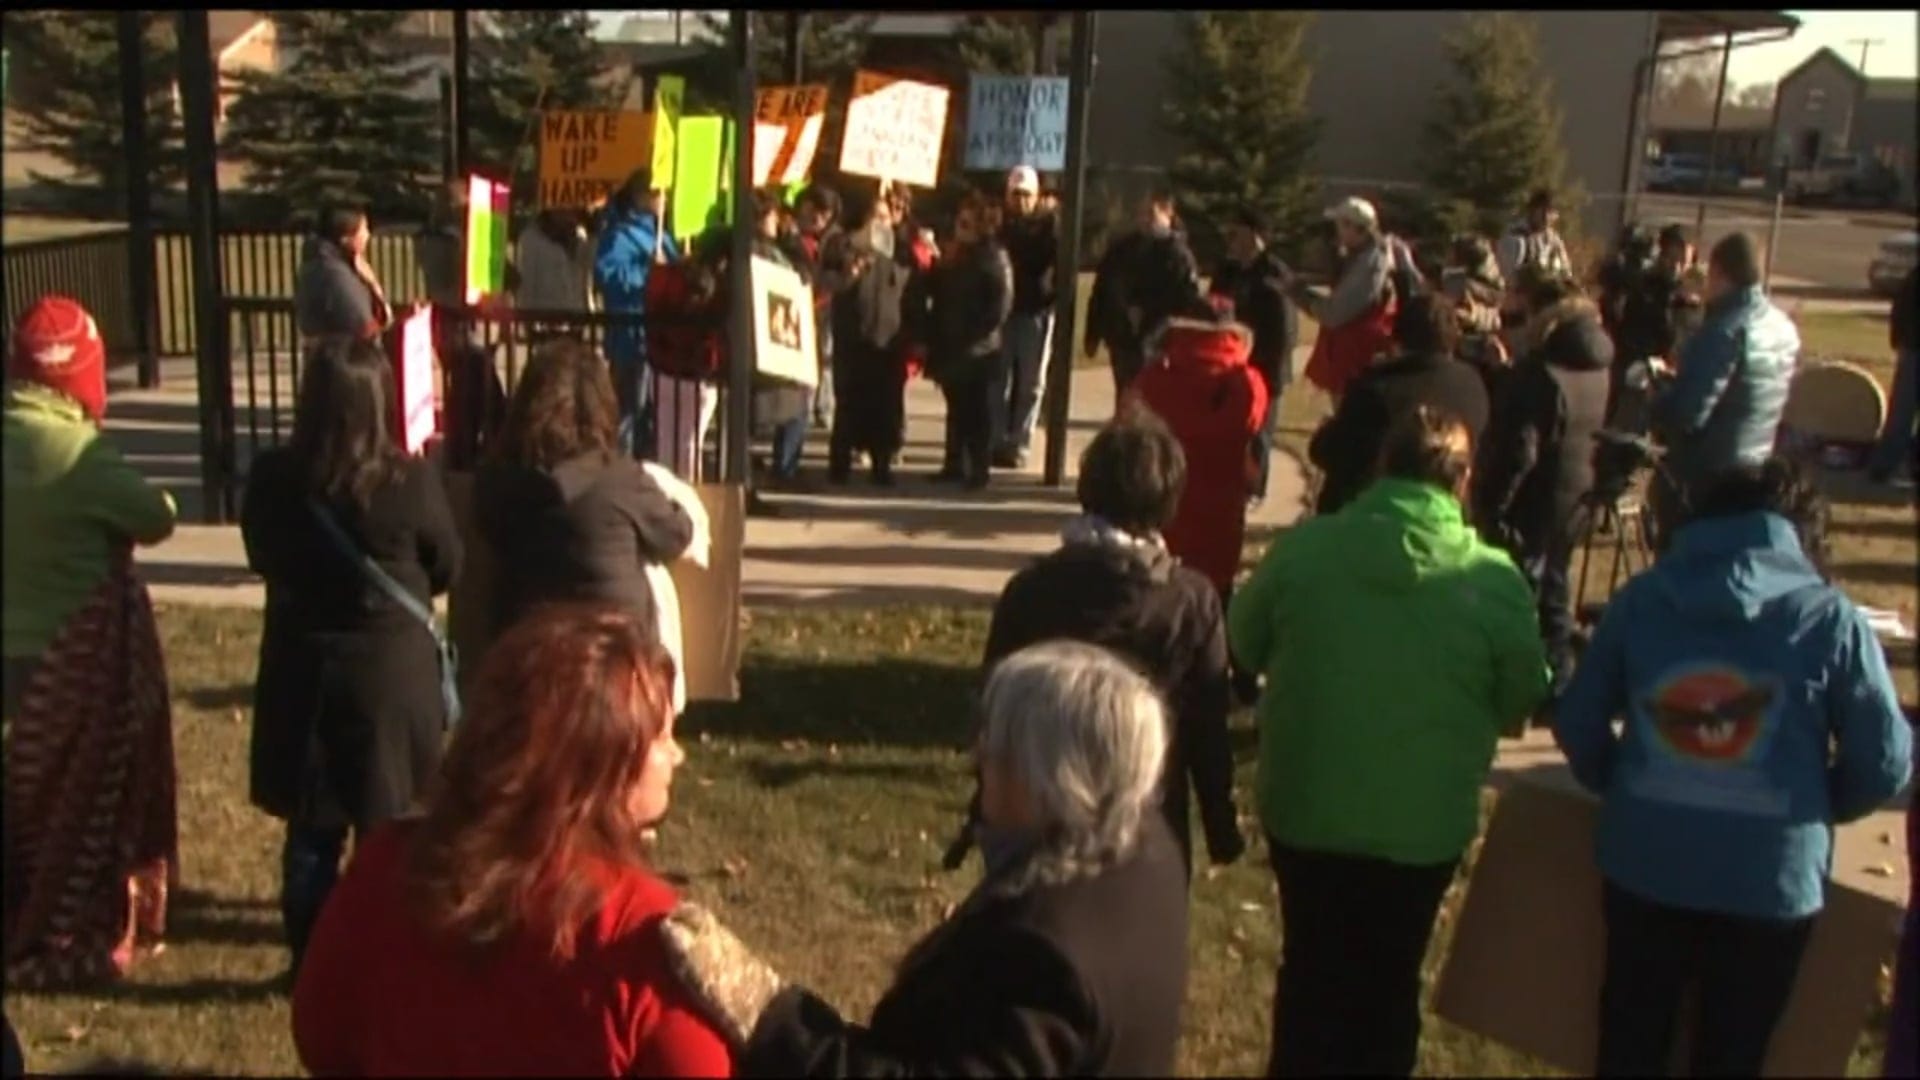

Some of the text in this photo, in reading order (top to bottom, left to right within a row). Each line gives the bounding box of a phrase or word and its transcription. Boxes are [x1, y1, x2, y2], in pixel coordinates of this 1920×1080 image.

[978, 82, 1063, 111] HONOR
[545, 114, 617, 142] WAKE
[561, 146, 599, 173] UP
